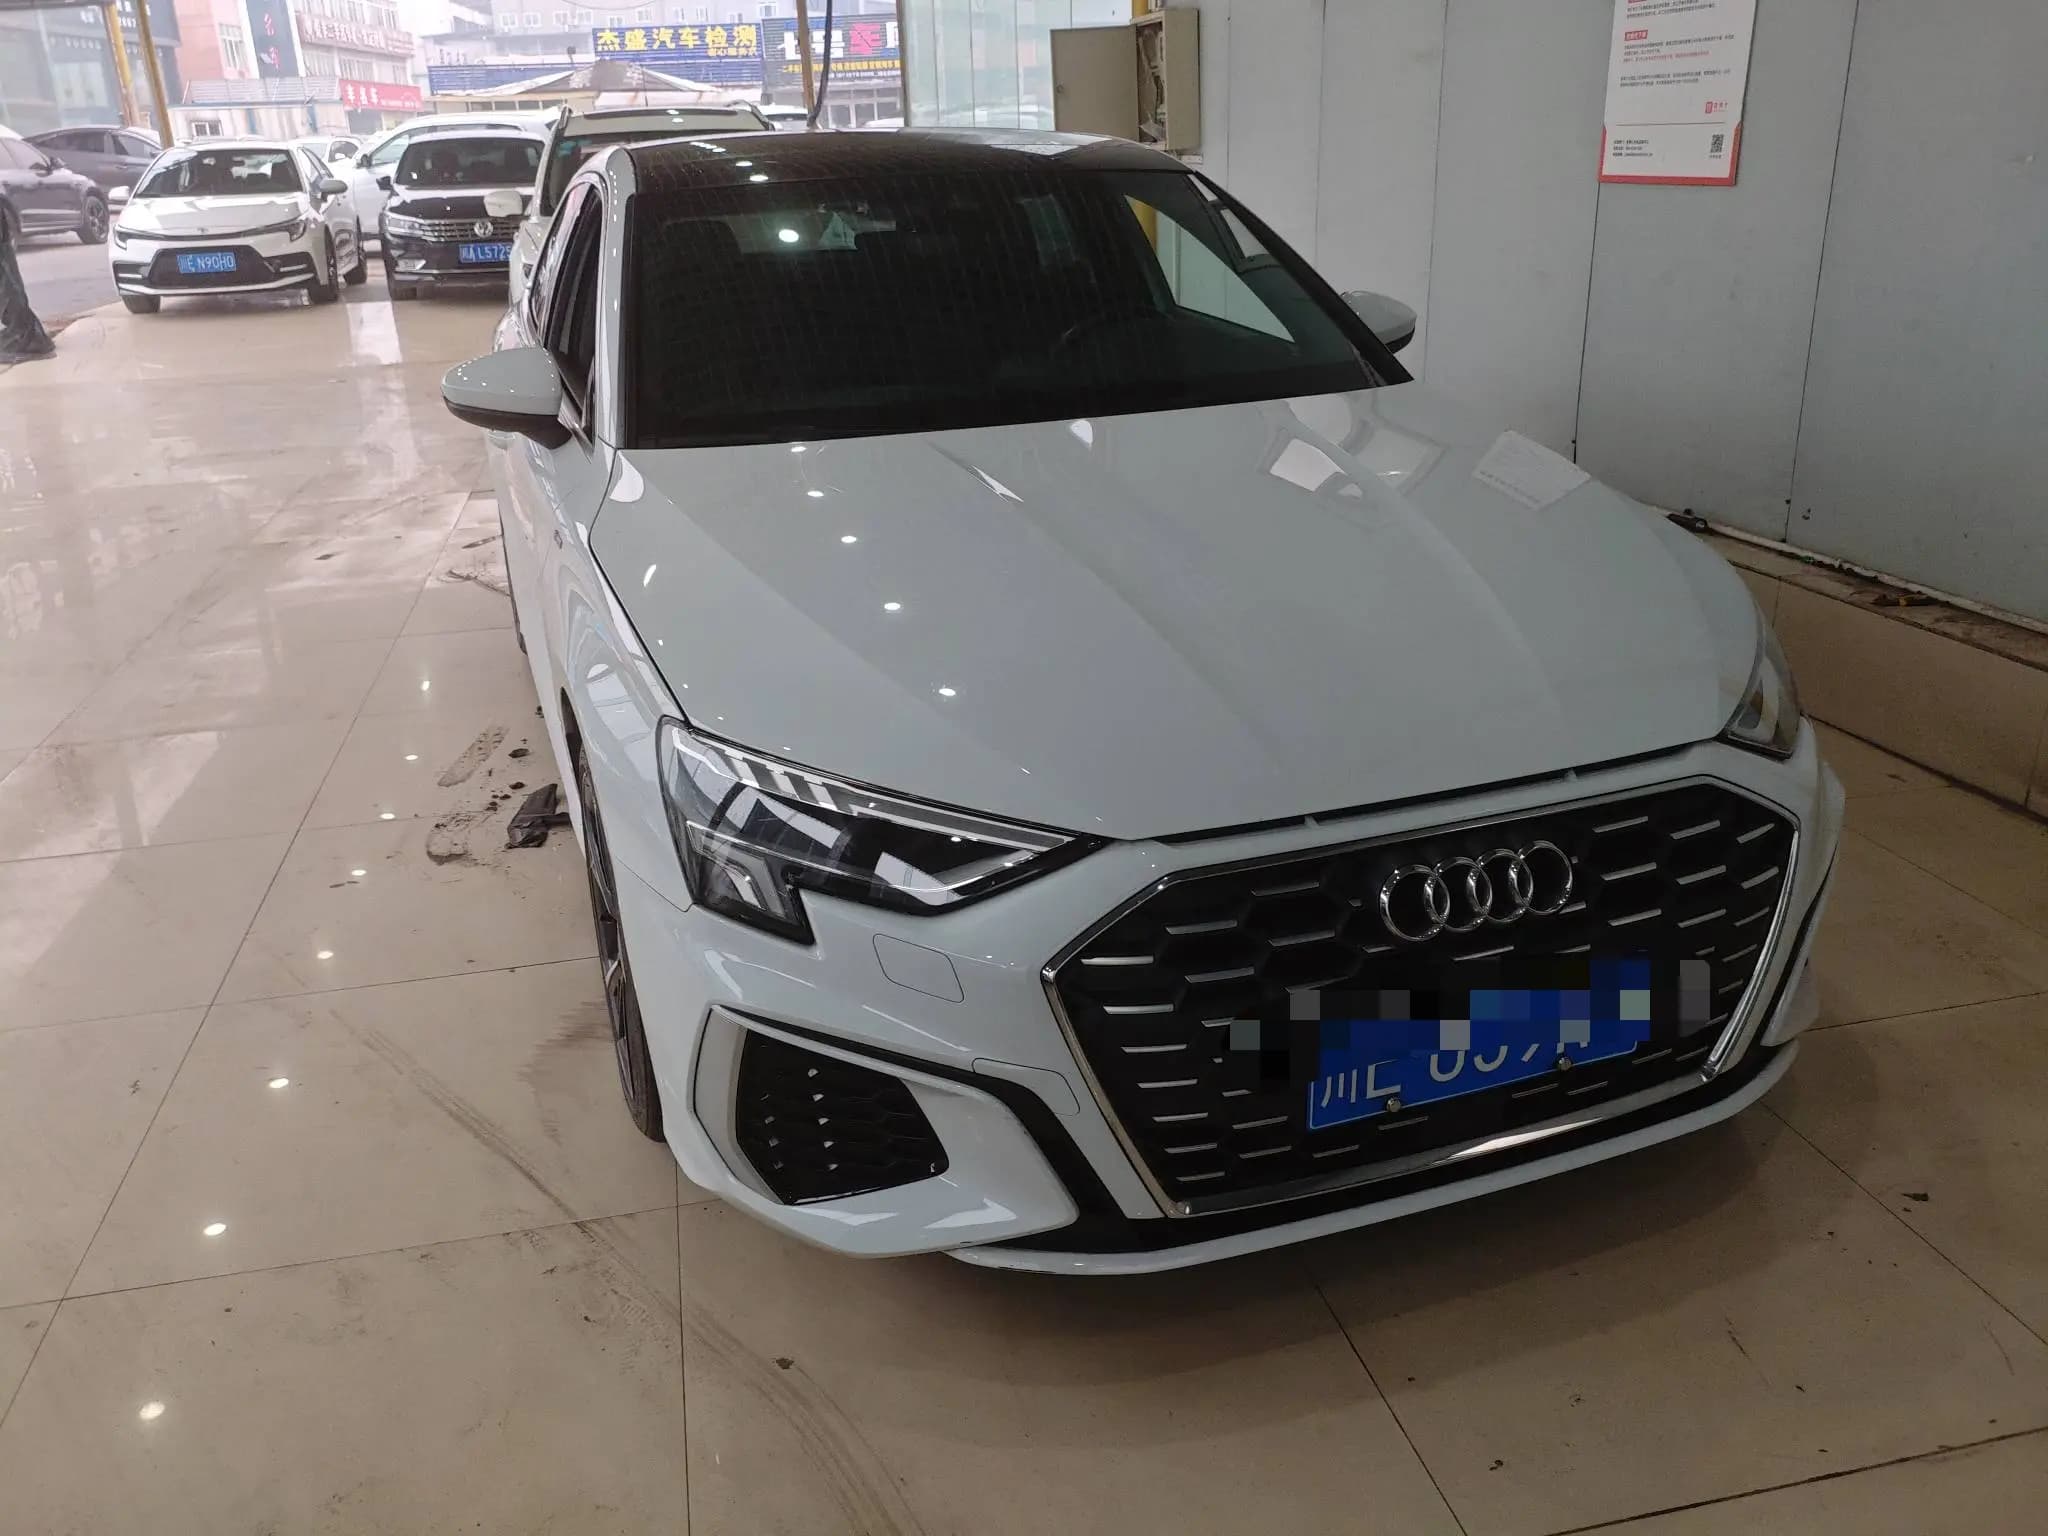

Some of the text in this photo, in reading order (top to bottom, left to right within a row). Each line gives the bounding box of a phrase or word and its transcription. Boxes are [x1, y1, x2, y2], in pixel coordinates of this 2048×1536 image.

[596, 24, 758, 51] 杰盛汽车检测
